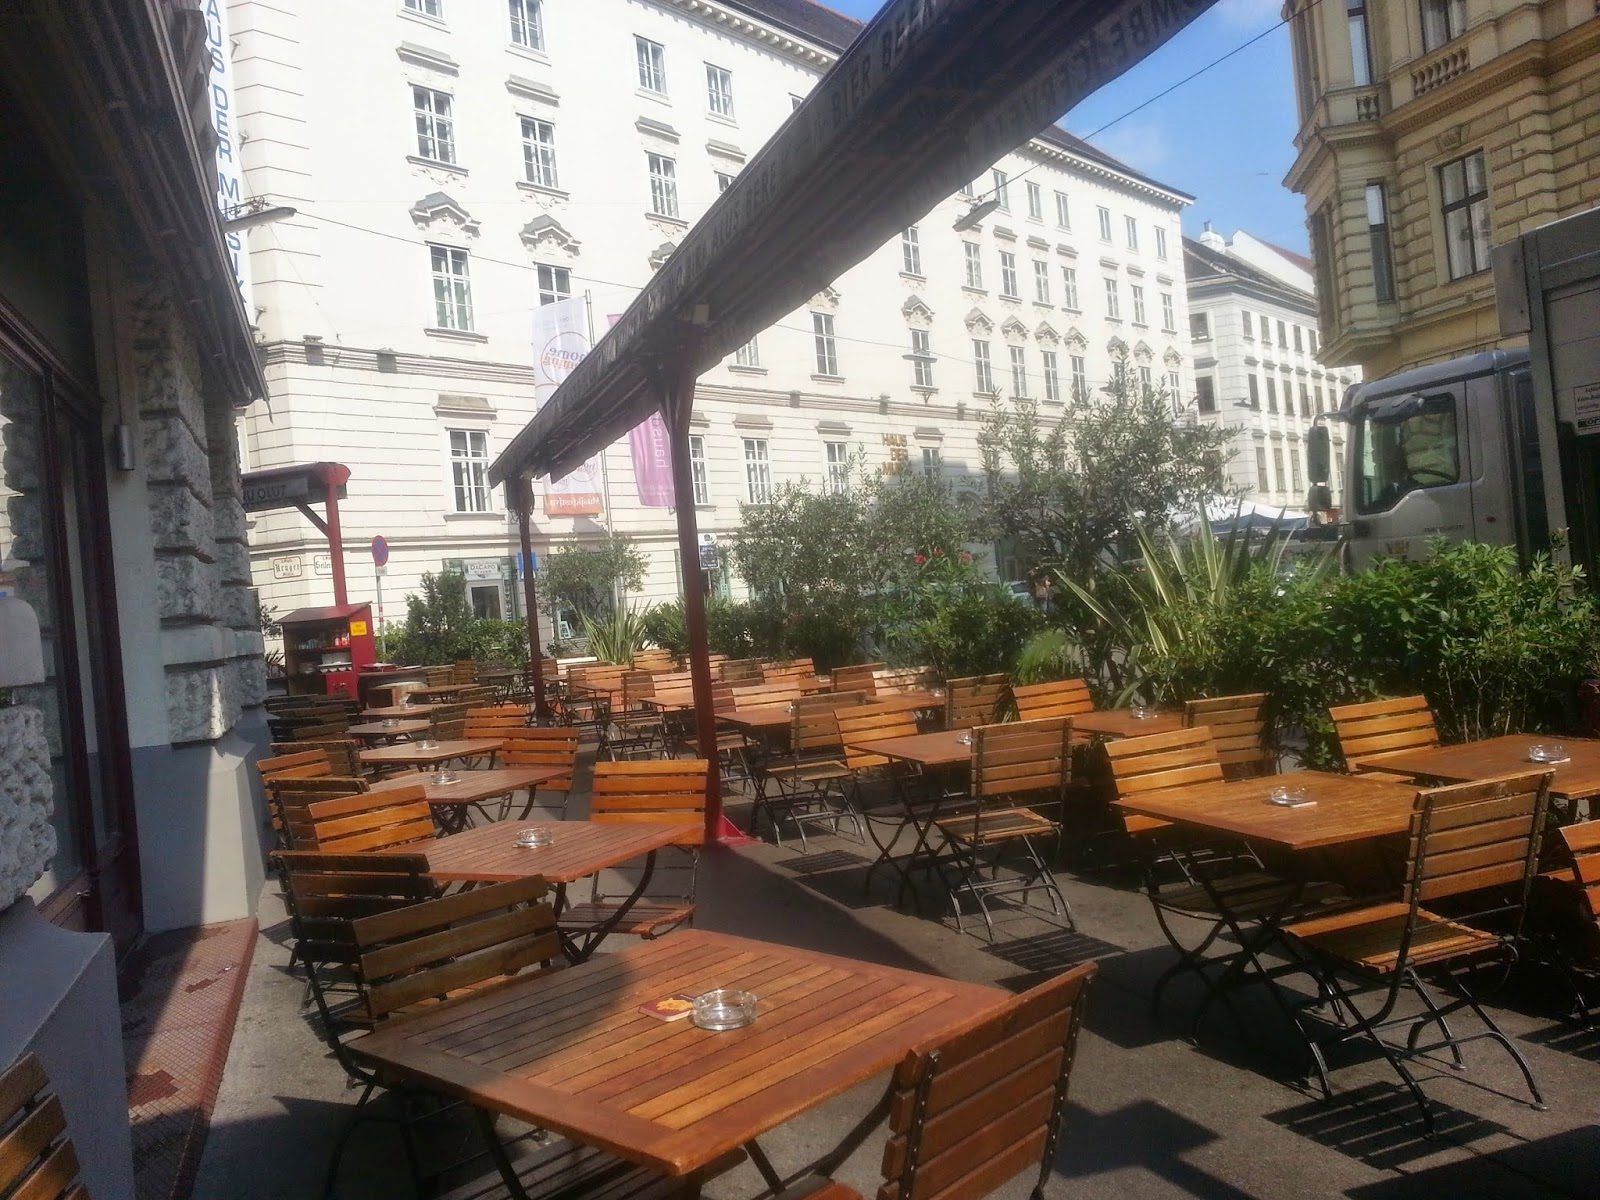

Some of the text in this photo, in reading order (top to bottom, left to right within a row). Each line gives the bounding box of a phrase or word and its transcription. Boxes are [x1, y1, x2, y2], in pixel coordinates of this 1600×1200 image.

[213, 84, 232, 163] DER
[883, 434, 907, 447] HAUS
[890, 448, 909, 461] DER
